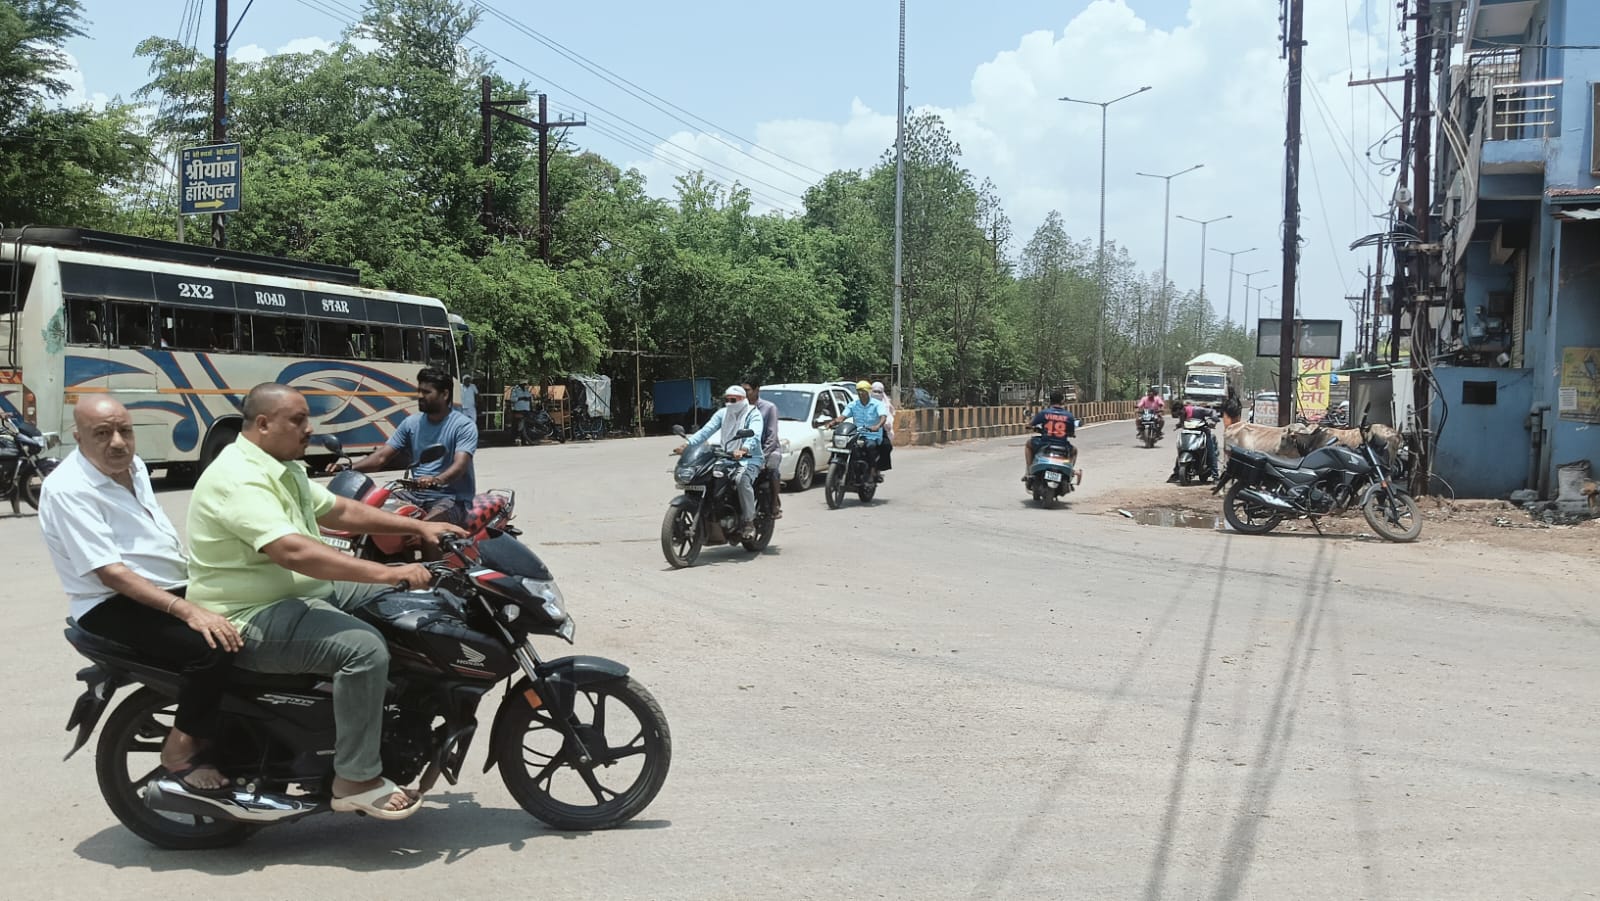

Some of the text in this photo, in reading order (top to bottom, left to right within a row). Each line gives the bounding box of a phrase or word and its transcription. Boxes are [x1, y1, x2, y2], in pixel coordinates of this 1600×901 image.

[185, 156, 237, 180] श्रीयांश
[185, 181, 236, 201] हॉस्पिटल
[178, 283, 350, 314] 2X2 ROAD STAR
